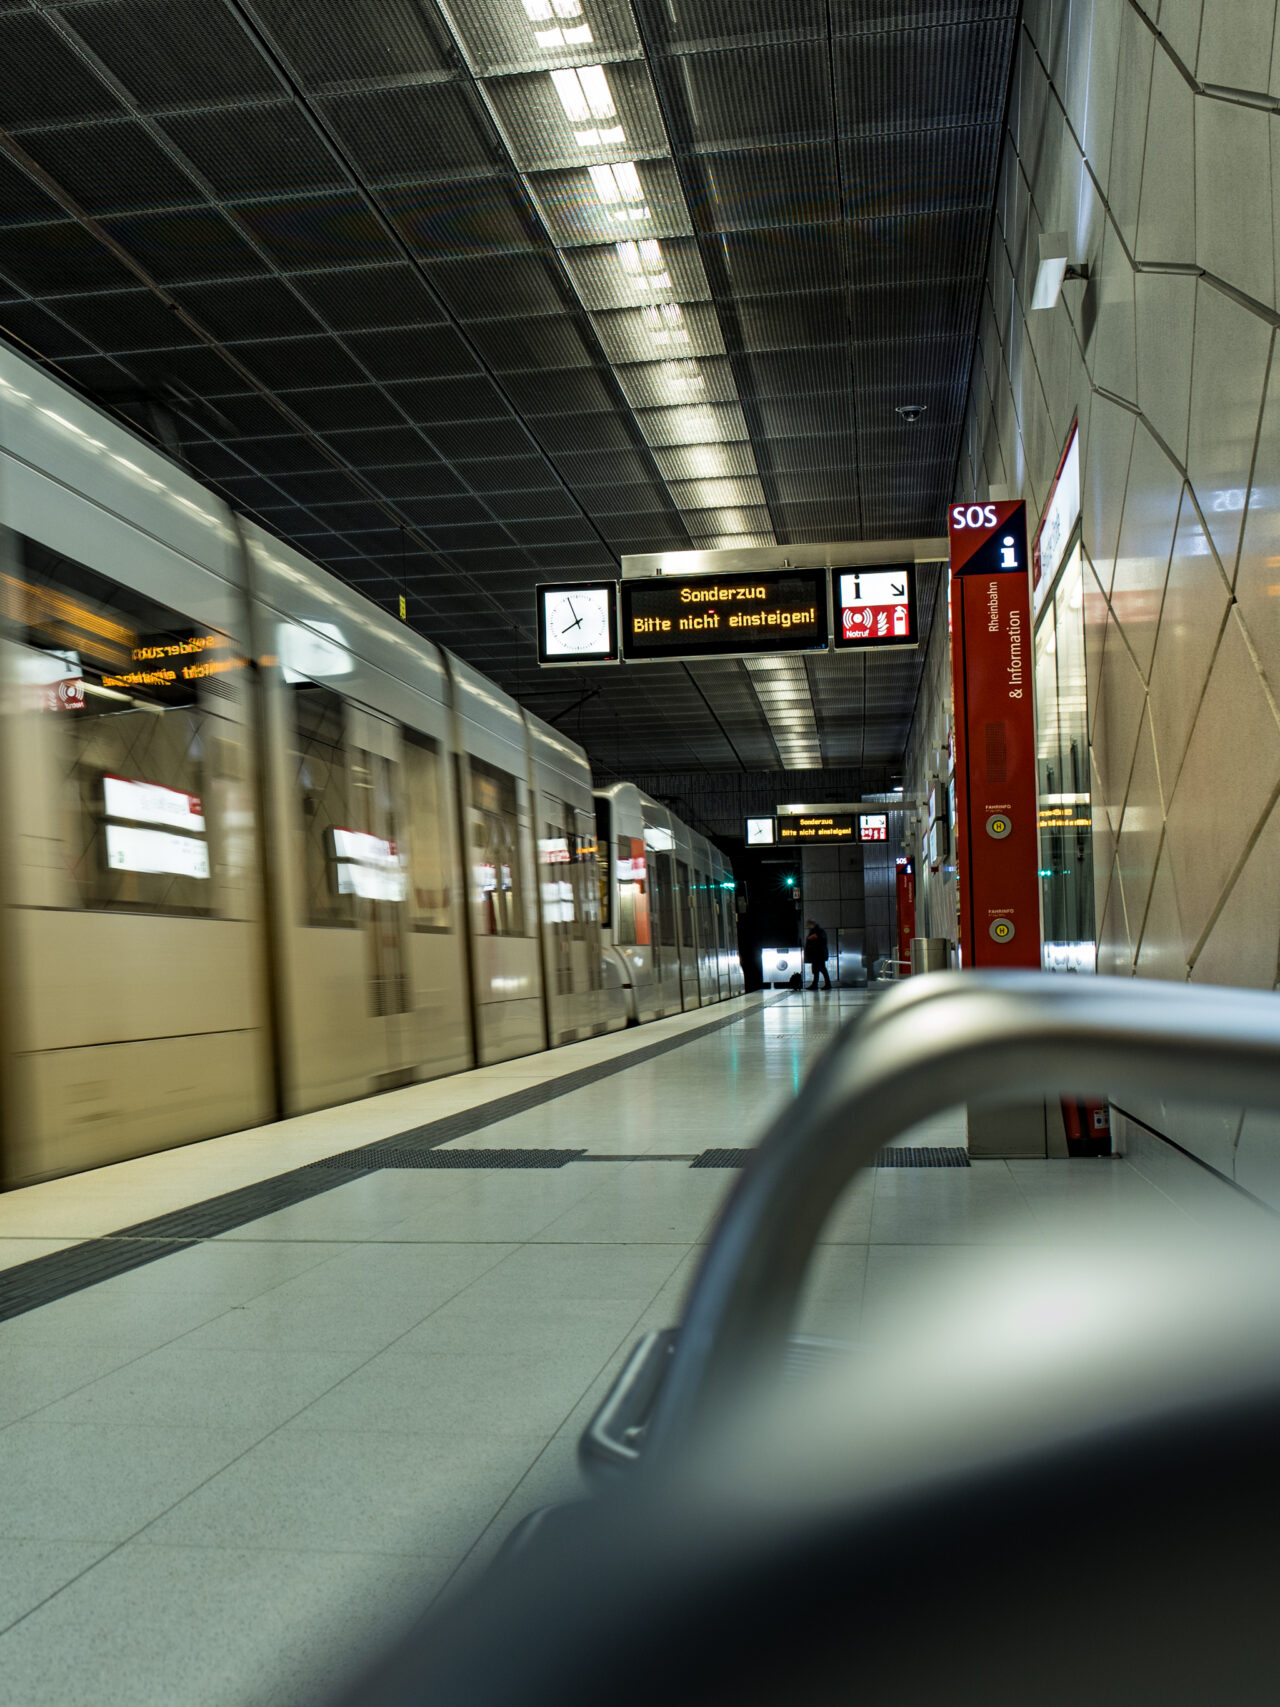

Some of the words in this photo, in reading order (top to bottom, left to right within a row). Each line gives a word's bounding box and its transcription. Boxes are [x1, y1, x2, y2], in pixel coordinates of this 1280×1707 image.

[952, 505, 998, 529] SOS
[987, 581, 999, 632] Rheinbahn
[633, 617, 671, 633] Bitte
[679, 614, 721, 630] nicht
[729, 608, 816, 628] einsteigen!
[846, 629, 869, 638] Notruf
[1007, 610, 1022, 684] Information
[1009, 688, 1023, 699] &
[799, 828, 816, 836] nicht
